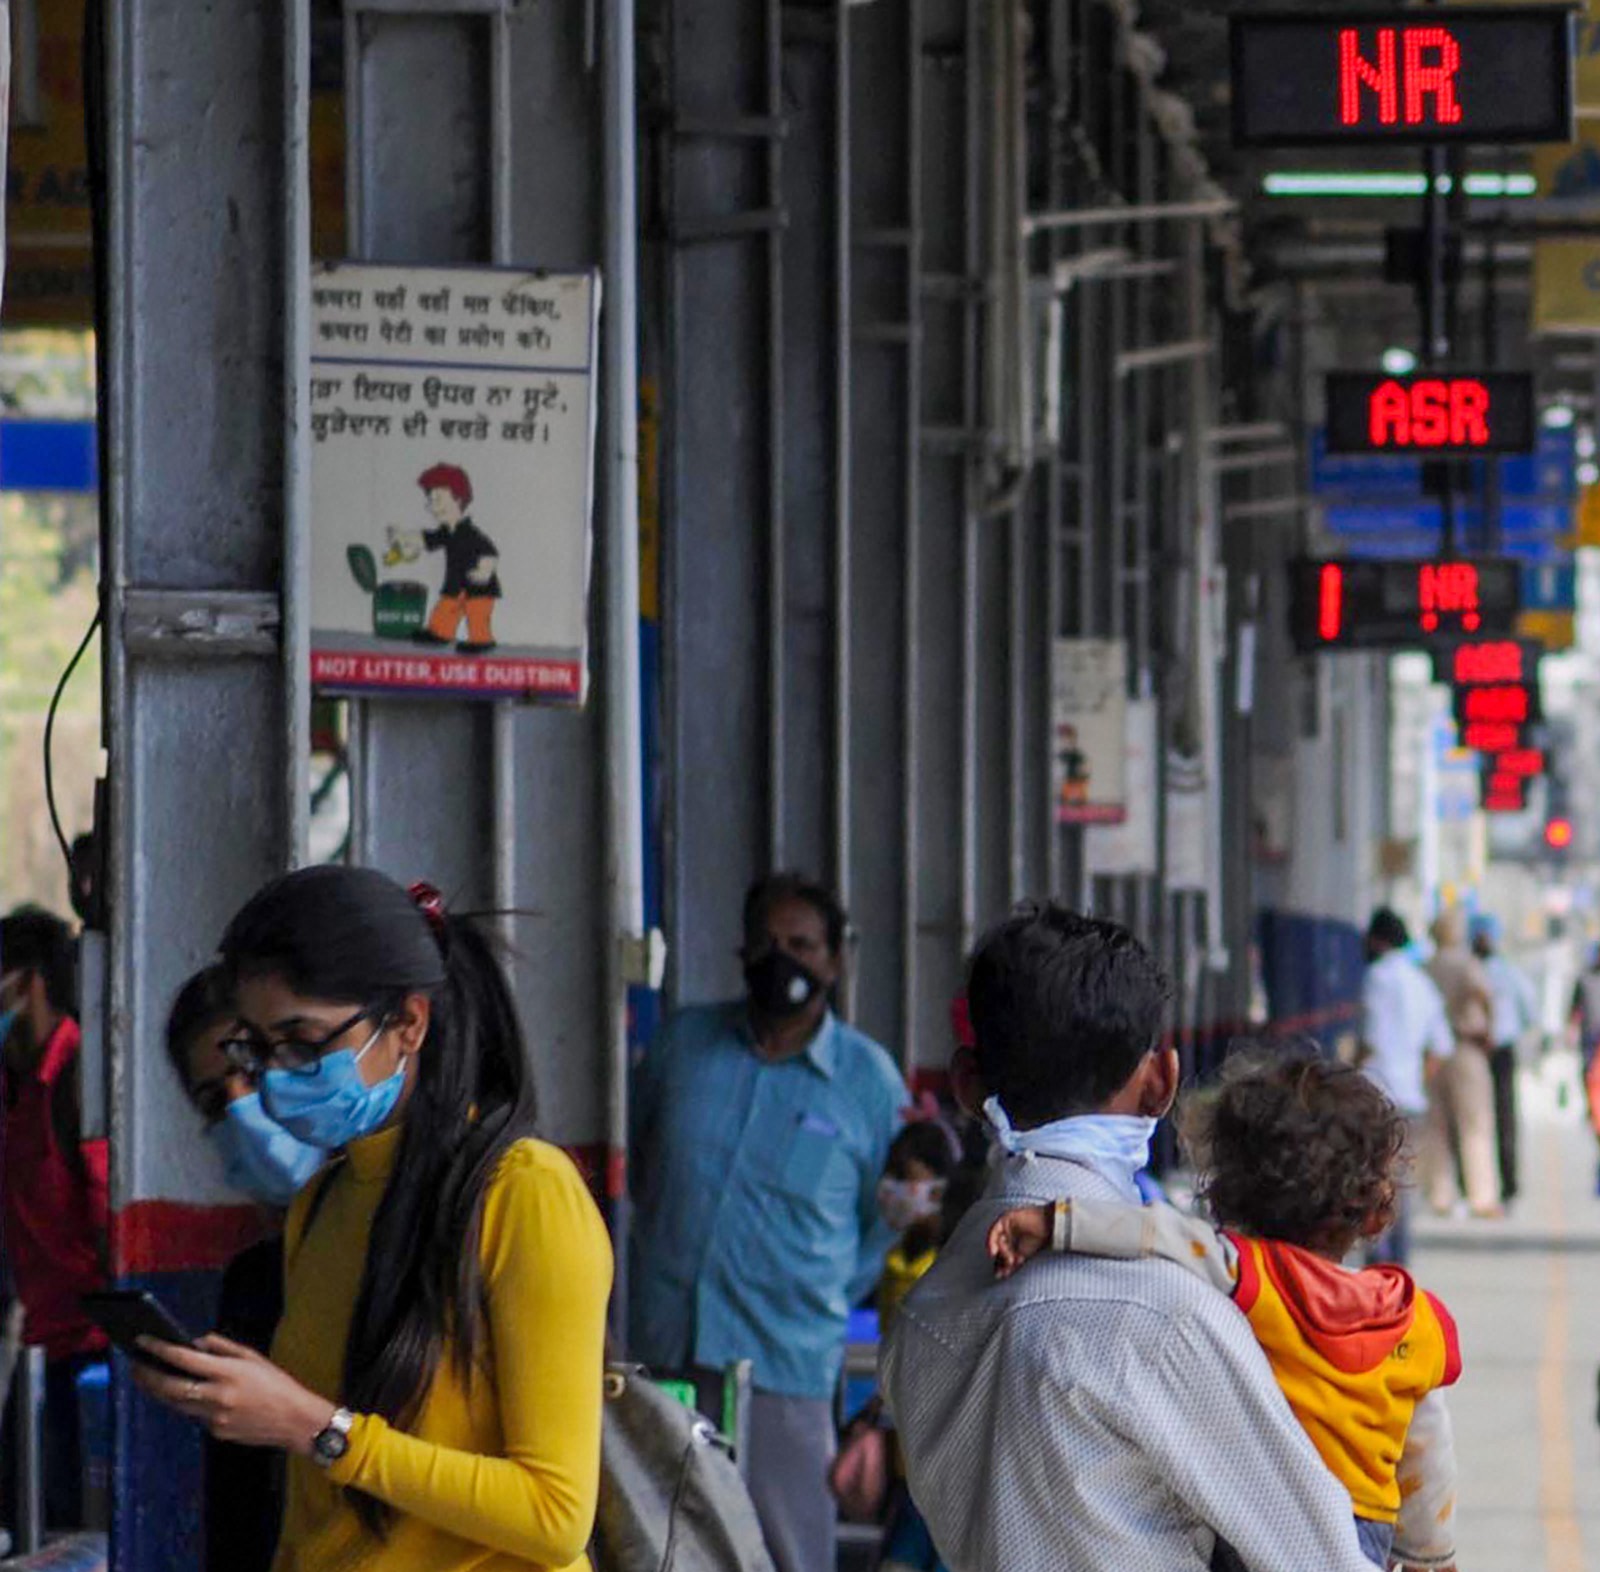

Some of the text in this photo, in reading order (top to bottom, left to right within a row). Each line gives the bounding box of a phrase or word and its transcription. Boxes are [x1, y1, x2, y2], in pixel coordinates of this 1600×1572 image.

[1339, 27, 1462, 125] NR
[319, 320, 368, 342] कचरा
[424, 326, 446, 347] का
[1370, 379, 1490, 448] ASR
[317, 656, 358, 678] NOT
[440, 662, 477, 682] USE
[485, 664, 573, 686] DUSTBIN
